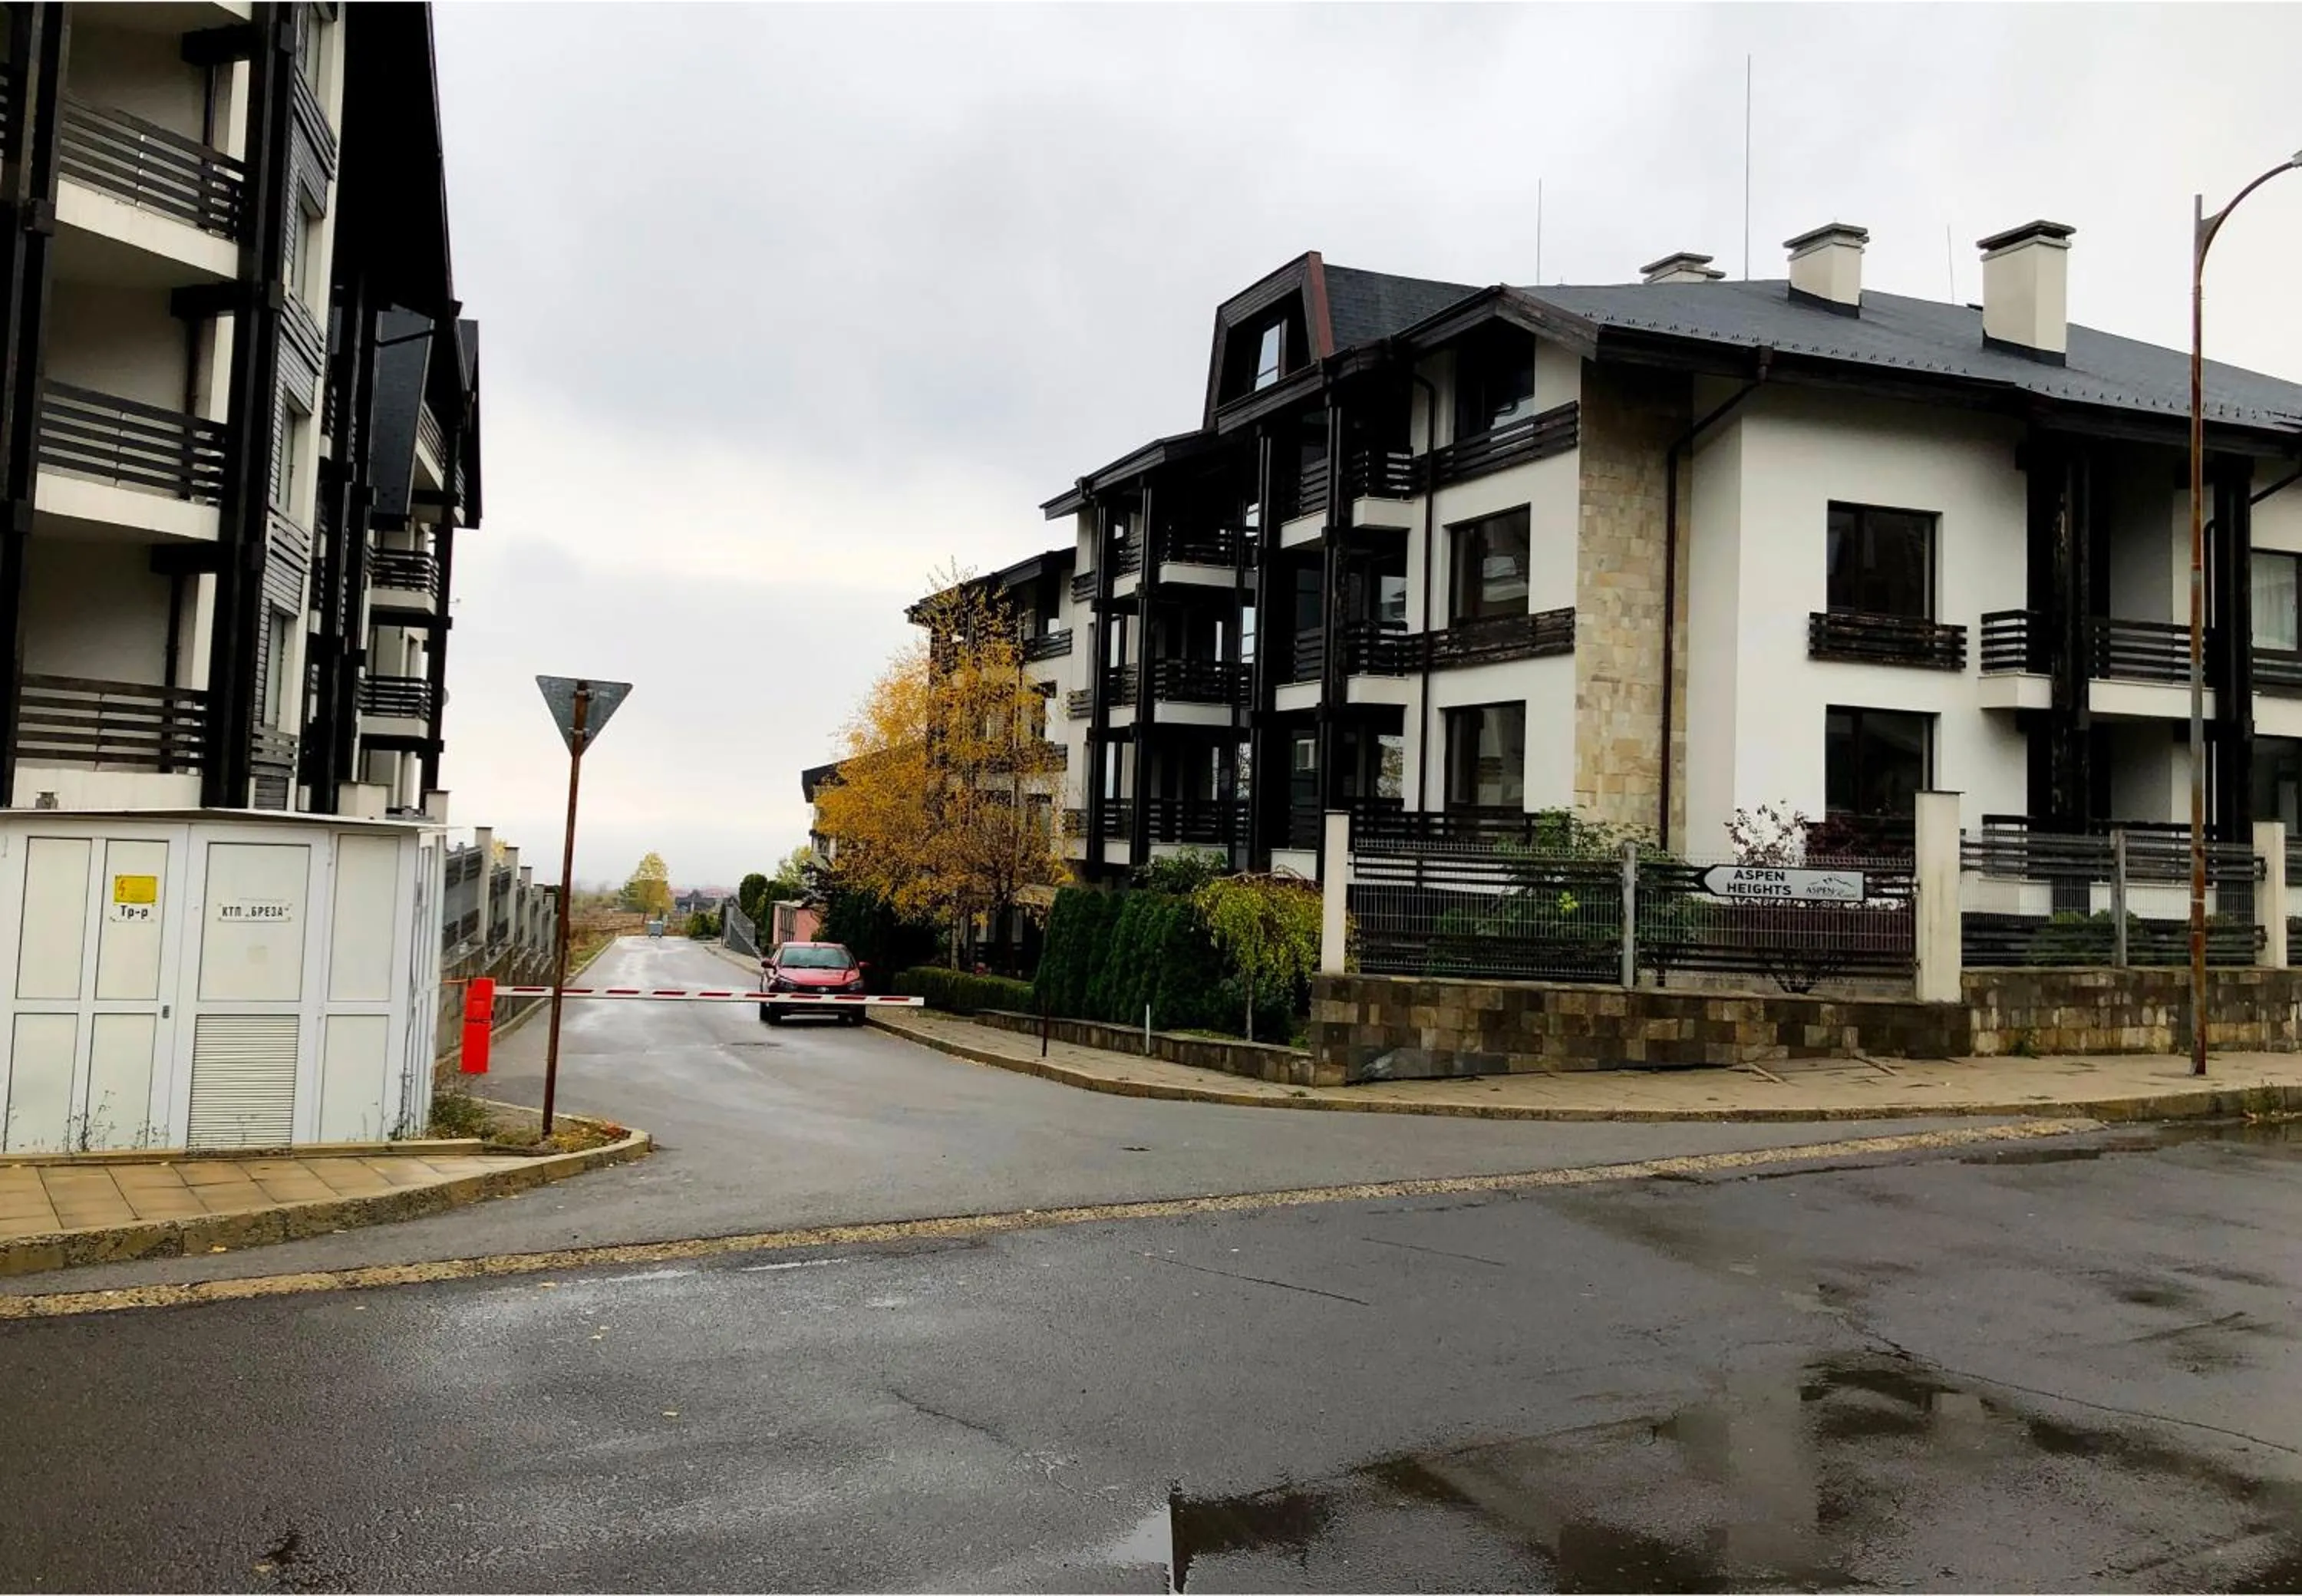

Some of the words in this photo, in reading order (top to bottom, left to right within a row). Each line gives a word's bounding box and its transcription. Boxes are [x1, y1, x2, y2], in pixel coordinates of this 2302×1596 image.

[1733, 869, 1786, 882] ASPEN
[1726, 883, 1792, 896] HEIGHTS
[1806, 886, 1835, 895] ASPEN
[222, 906, 242, 917] КТП
